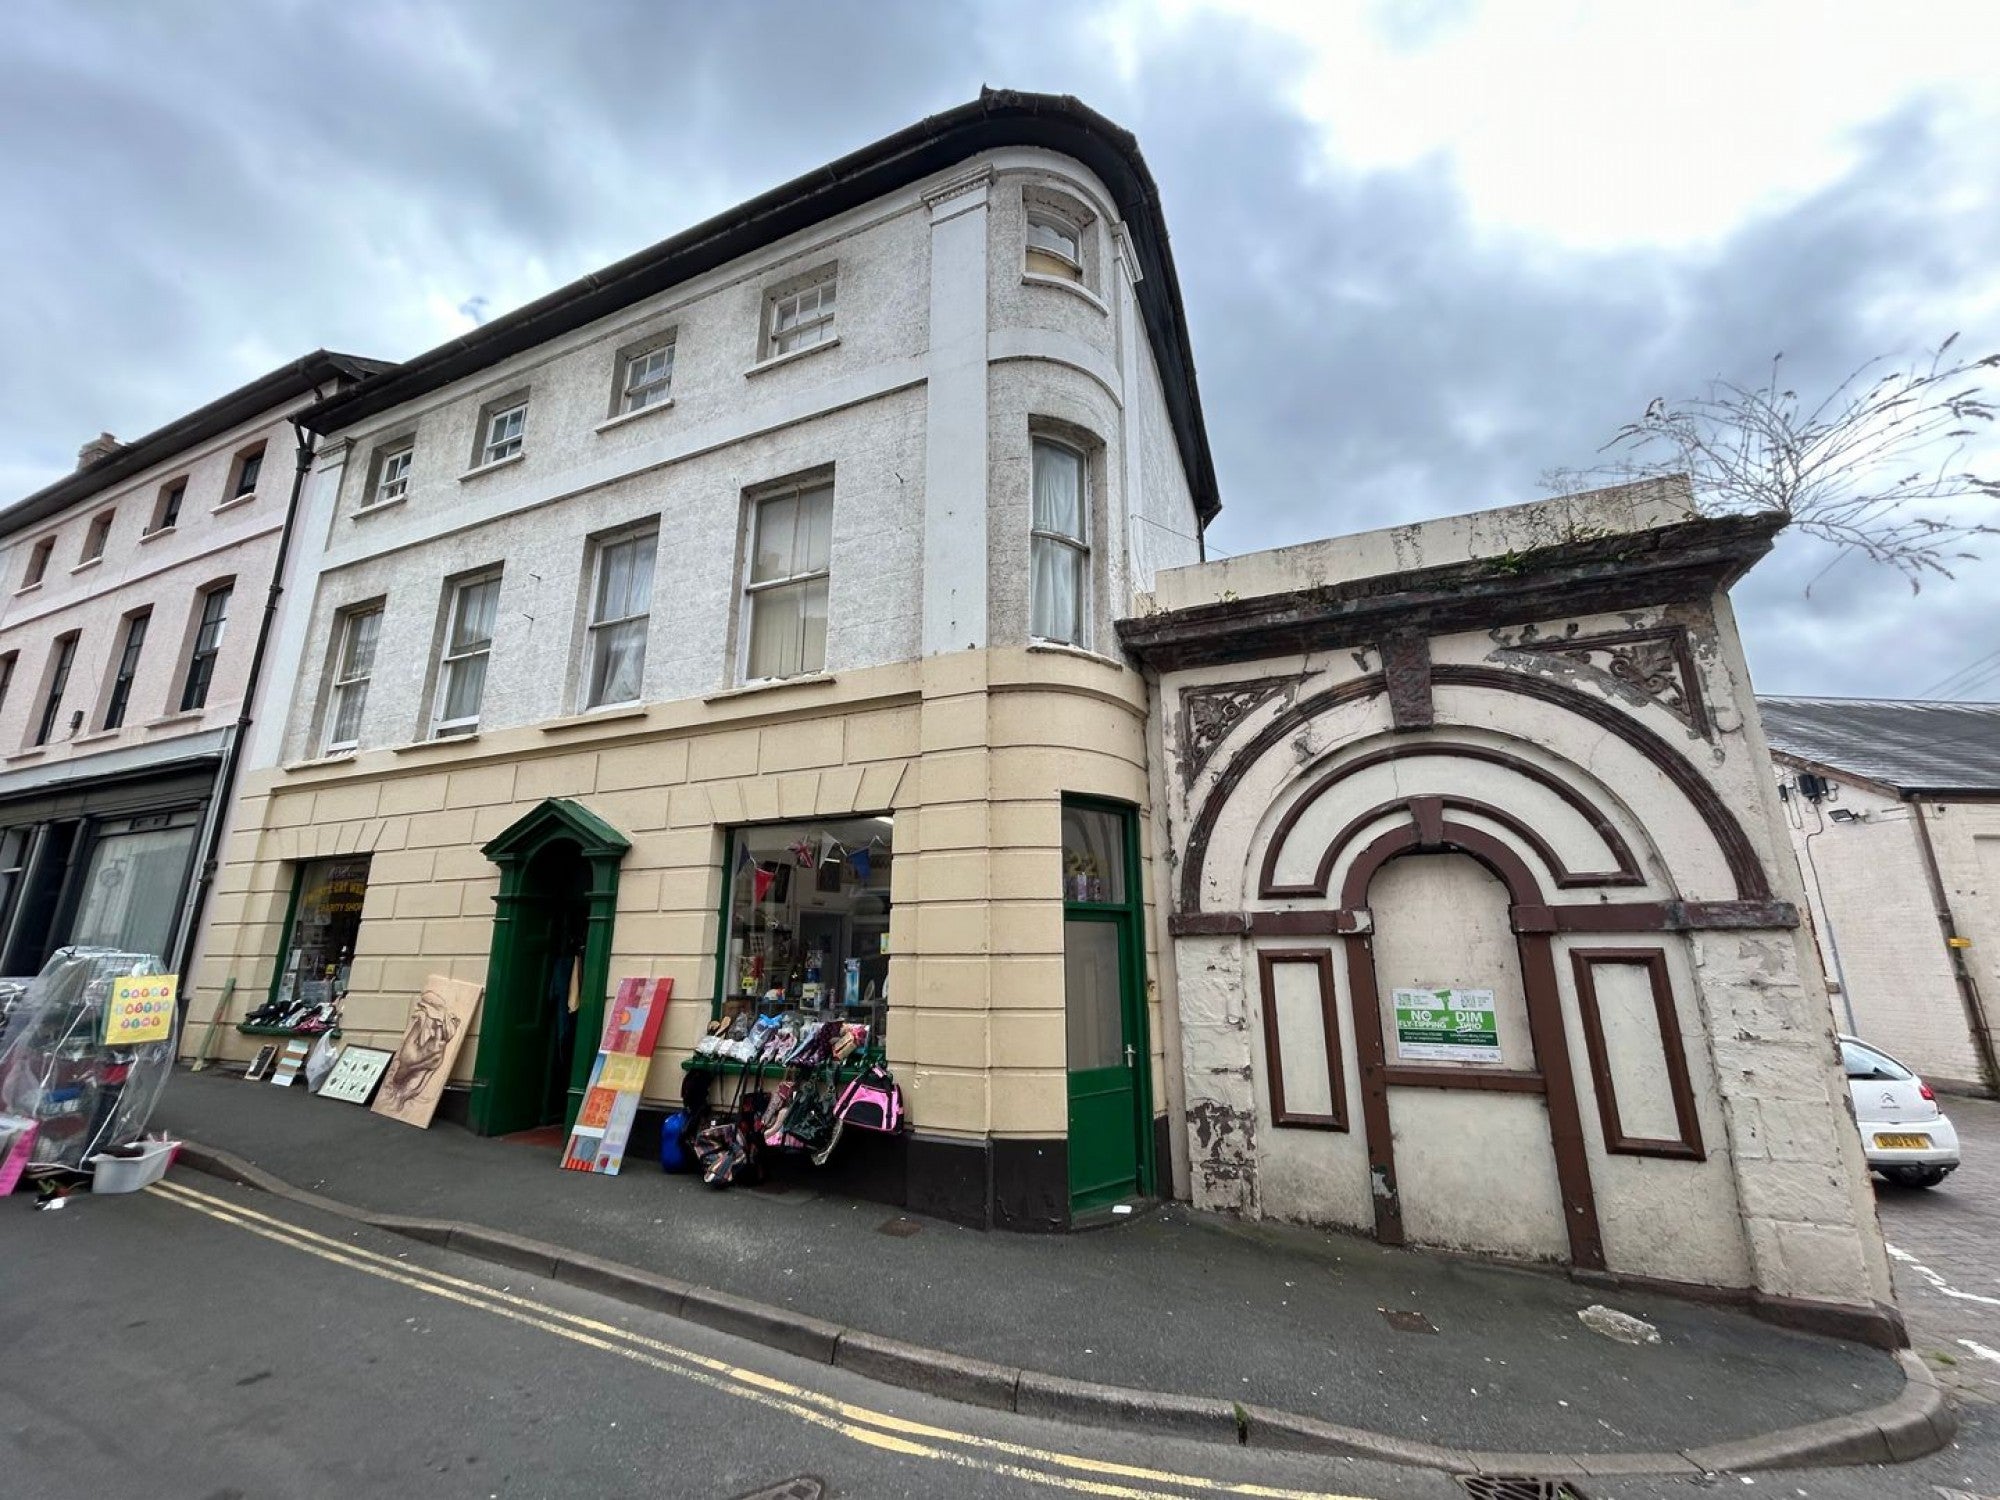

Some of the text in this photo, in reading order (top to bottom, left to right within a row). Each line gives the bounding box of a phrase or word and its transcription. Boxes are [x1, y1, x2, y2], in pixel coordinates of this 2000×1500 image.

[121, 987, 169, 998] HAPPY
[1411, 1010, 1433, 1021] NO
[1455, 1011, 1483, 1023] DIM
